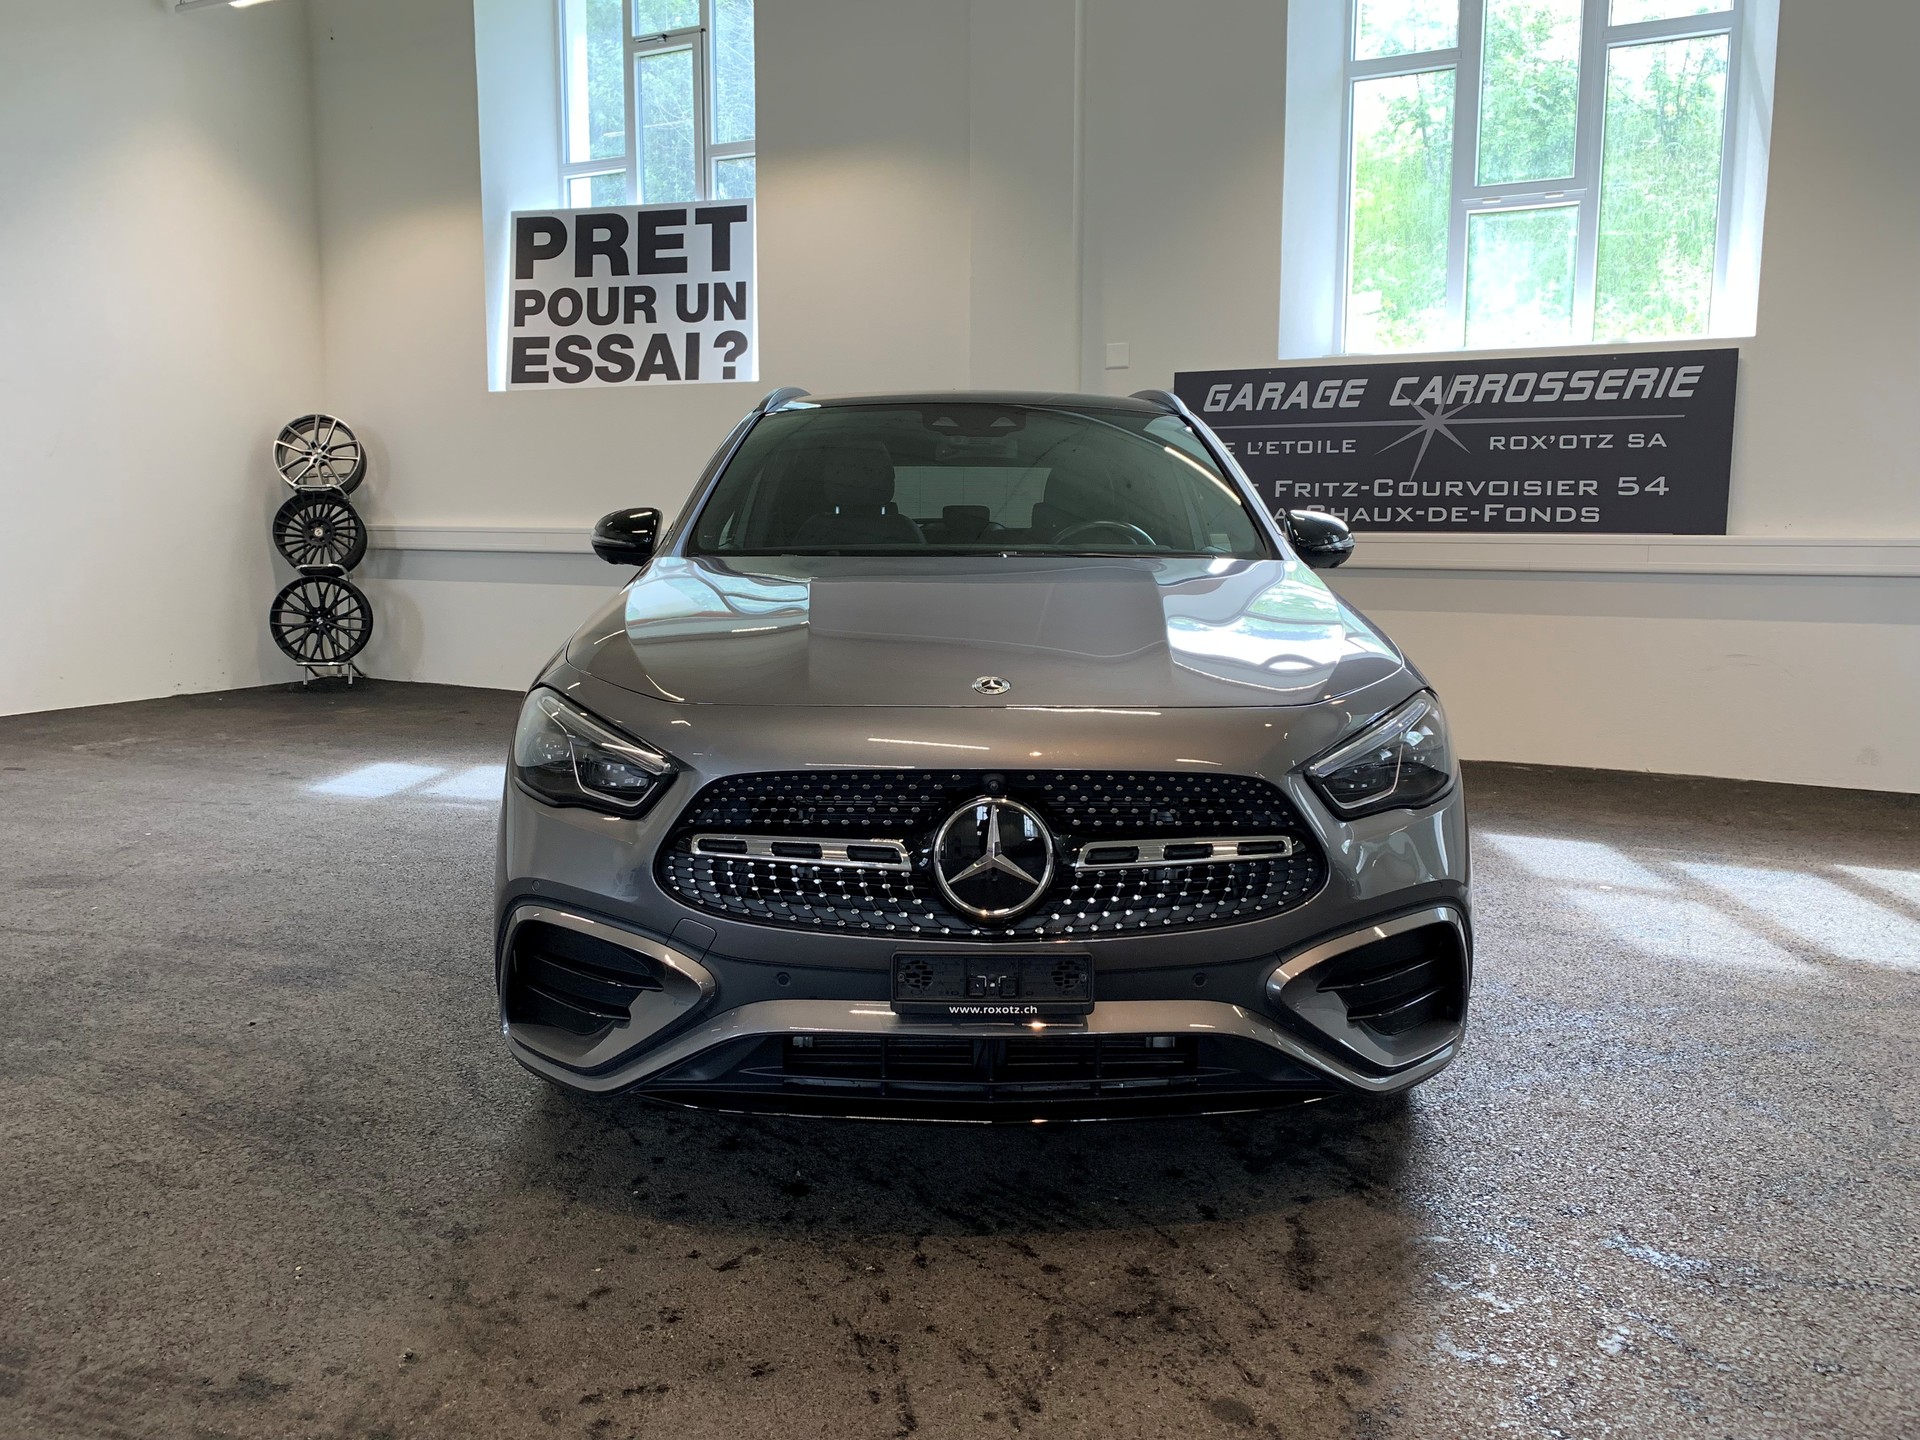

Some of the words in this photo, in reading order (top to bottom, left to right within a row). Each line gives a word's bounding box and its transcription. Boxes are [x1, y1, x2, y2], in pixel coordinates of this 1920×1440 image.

[515, 205, 747, 279] PRET
[514, 286, 657, 327] POUR
[676, 281, 746, 323] UN
[511, 333, 700, 383] ESSAI
[1203, 379, 1368, 412] GARAGE
[1389, 366, 1704, 406] CARROSSERIE
[1627, 432, 1667, 448] SA
[1617, 476, 1669, 496] 54
[949, 1005, 1038, 1014] www.roxotz.ch
